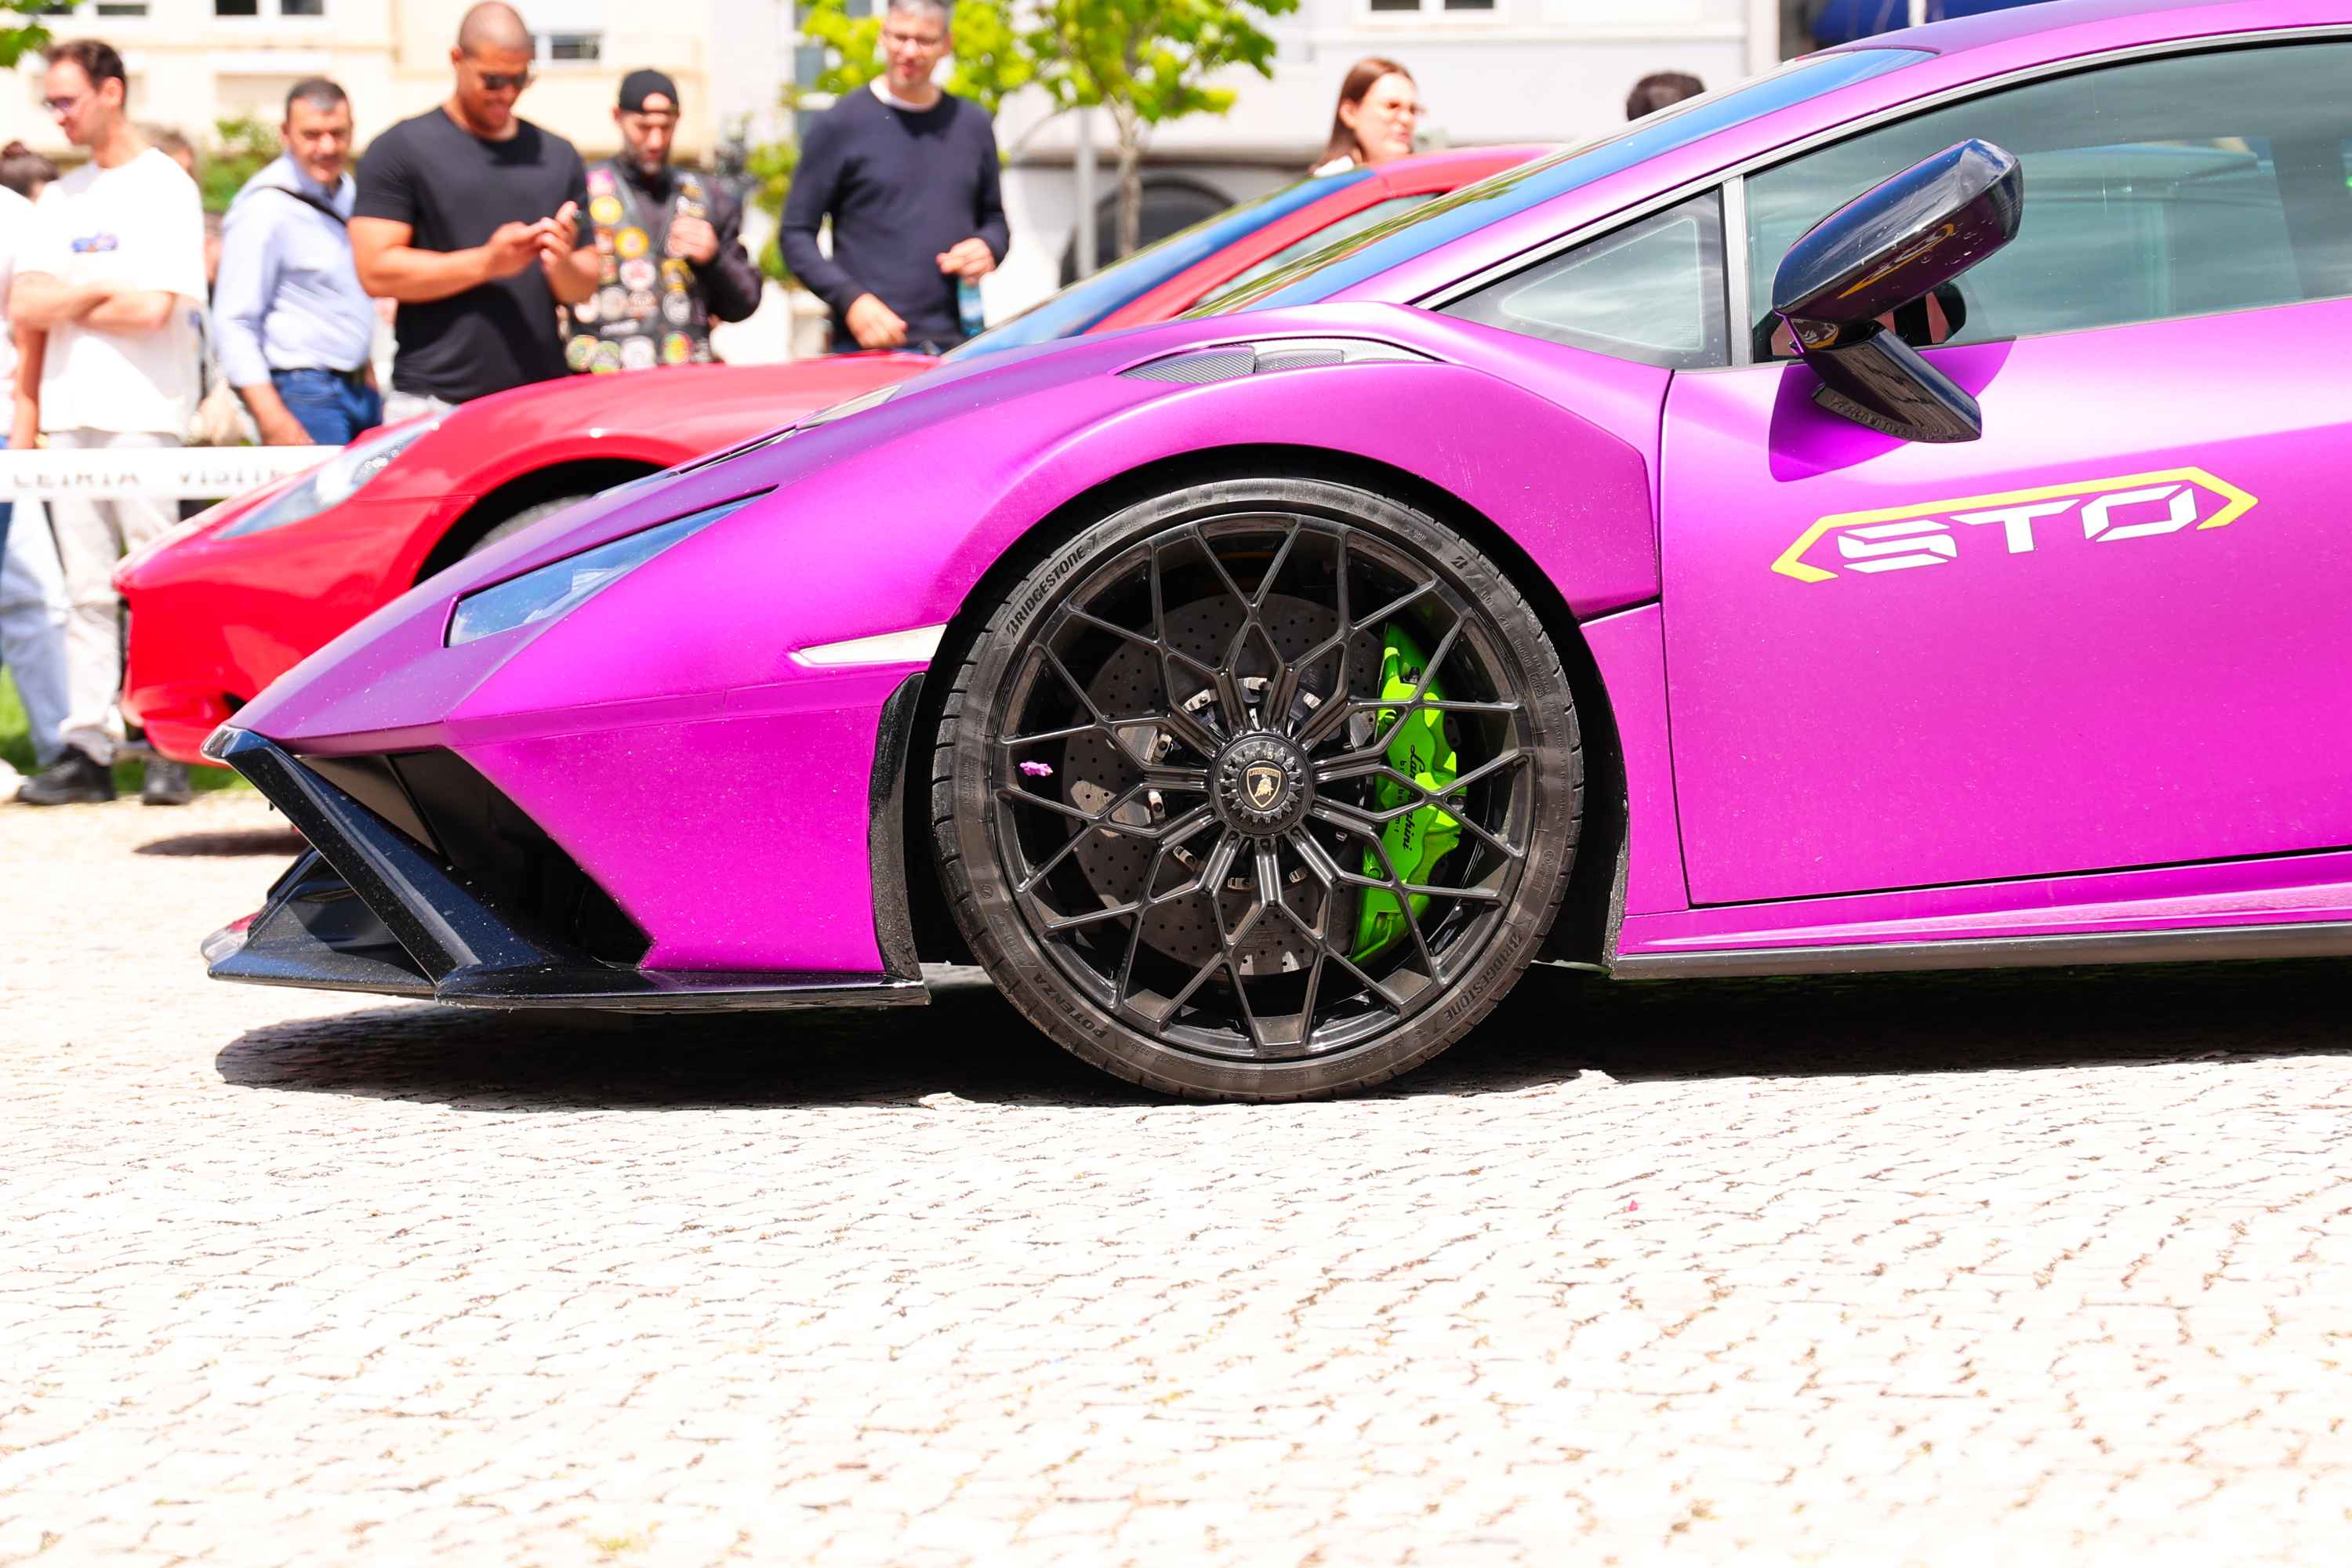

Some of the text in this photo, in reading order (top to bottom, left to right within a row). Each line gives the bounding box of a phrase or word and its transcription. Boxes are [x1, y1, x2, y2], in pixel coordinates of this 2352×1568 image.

[1838, 485, 2198, 573] STO
[1005, 545, 1087, 638] BRIDGESTONE
[1033, 971, 1109, 1040] POTENZA
[1443, 931, 1523, 1023] BRIDGESTONE
